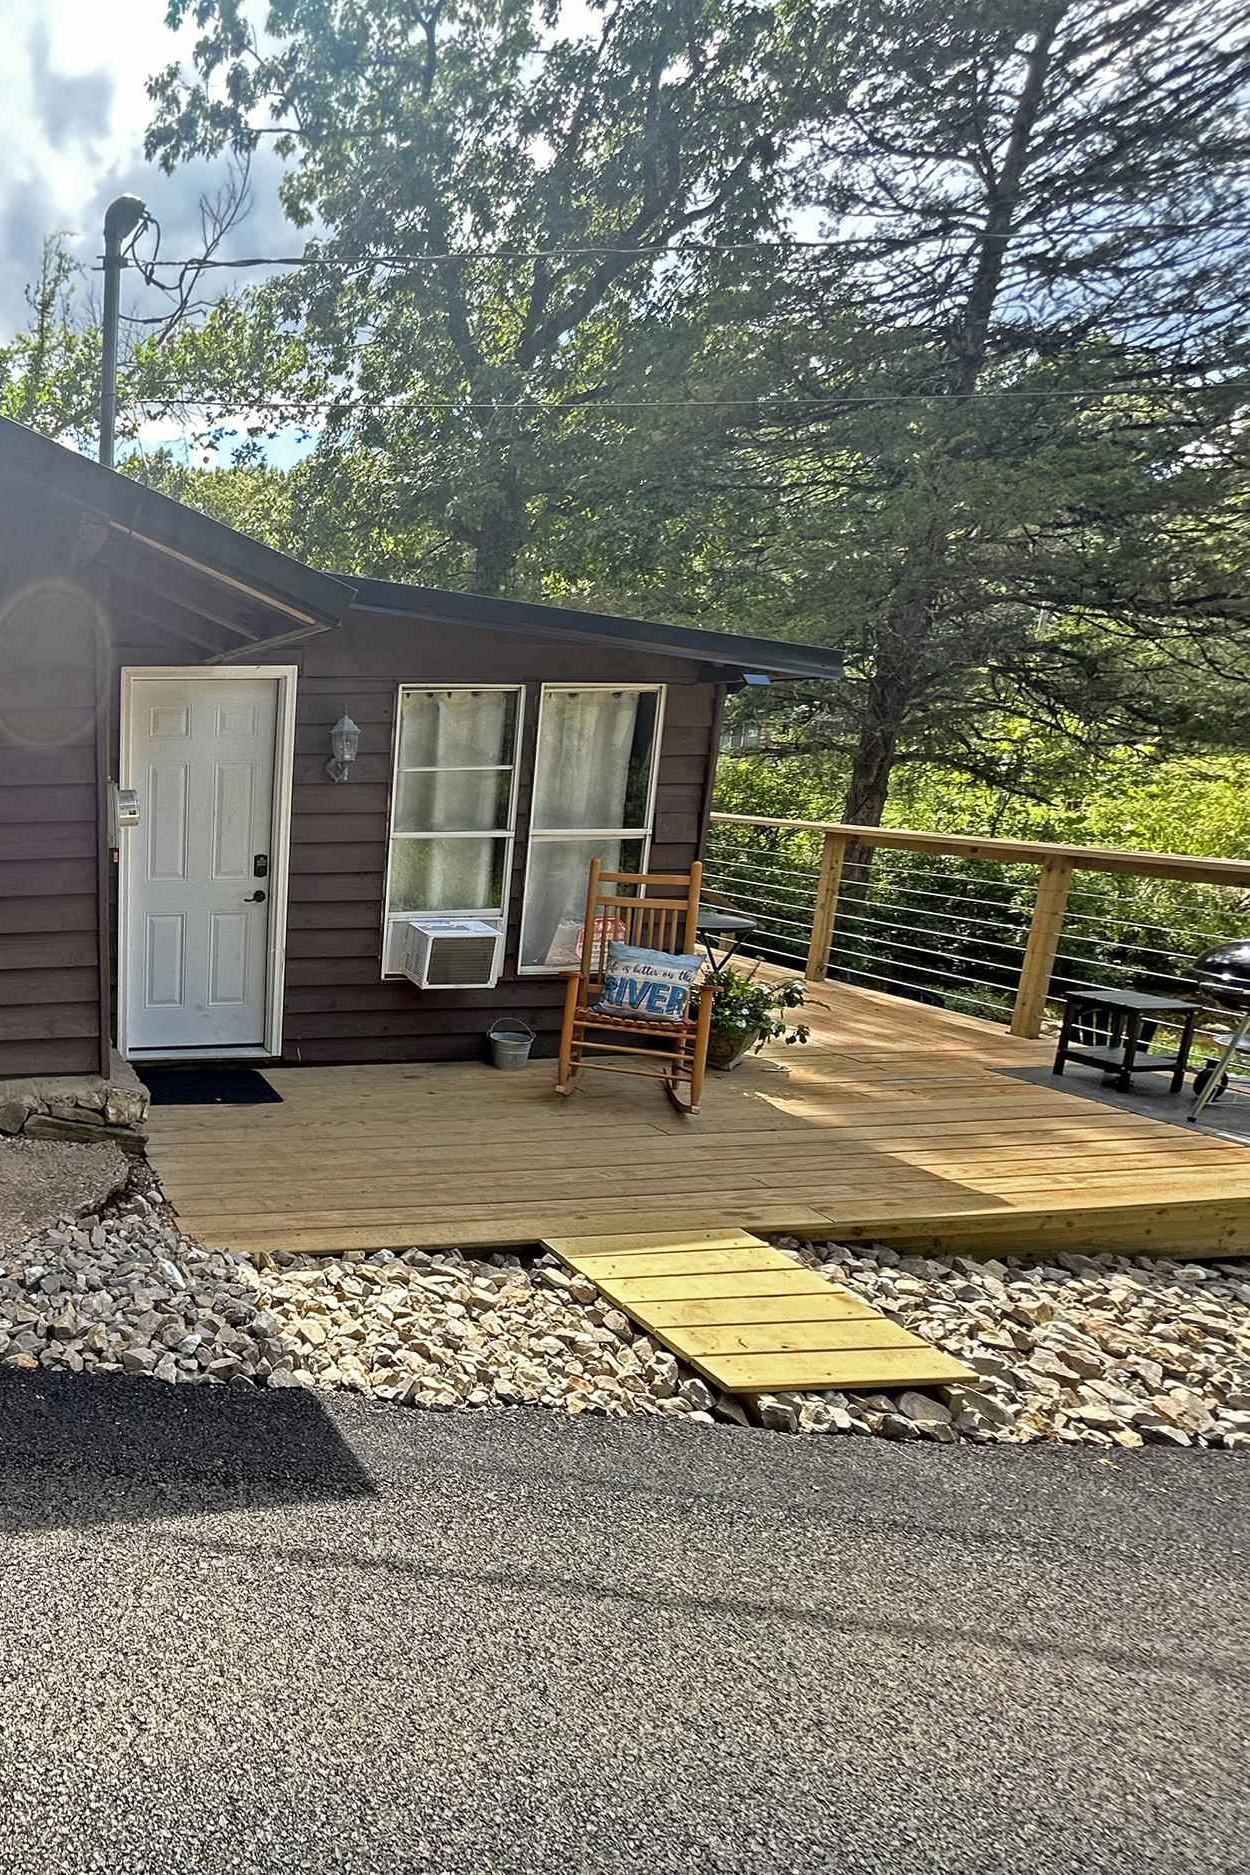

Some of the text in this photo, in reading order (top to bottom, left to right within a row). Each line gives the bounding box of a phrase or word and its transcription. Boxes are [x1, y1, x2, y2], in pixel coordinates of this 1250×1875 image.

[632, 963, 658, 977] better
[661, 971, 674, 980] on
[678, 969, 694, 983] the
[606, 975, 687, 1014] RIVER
